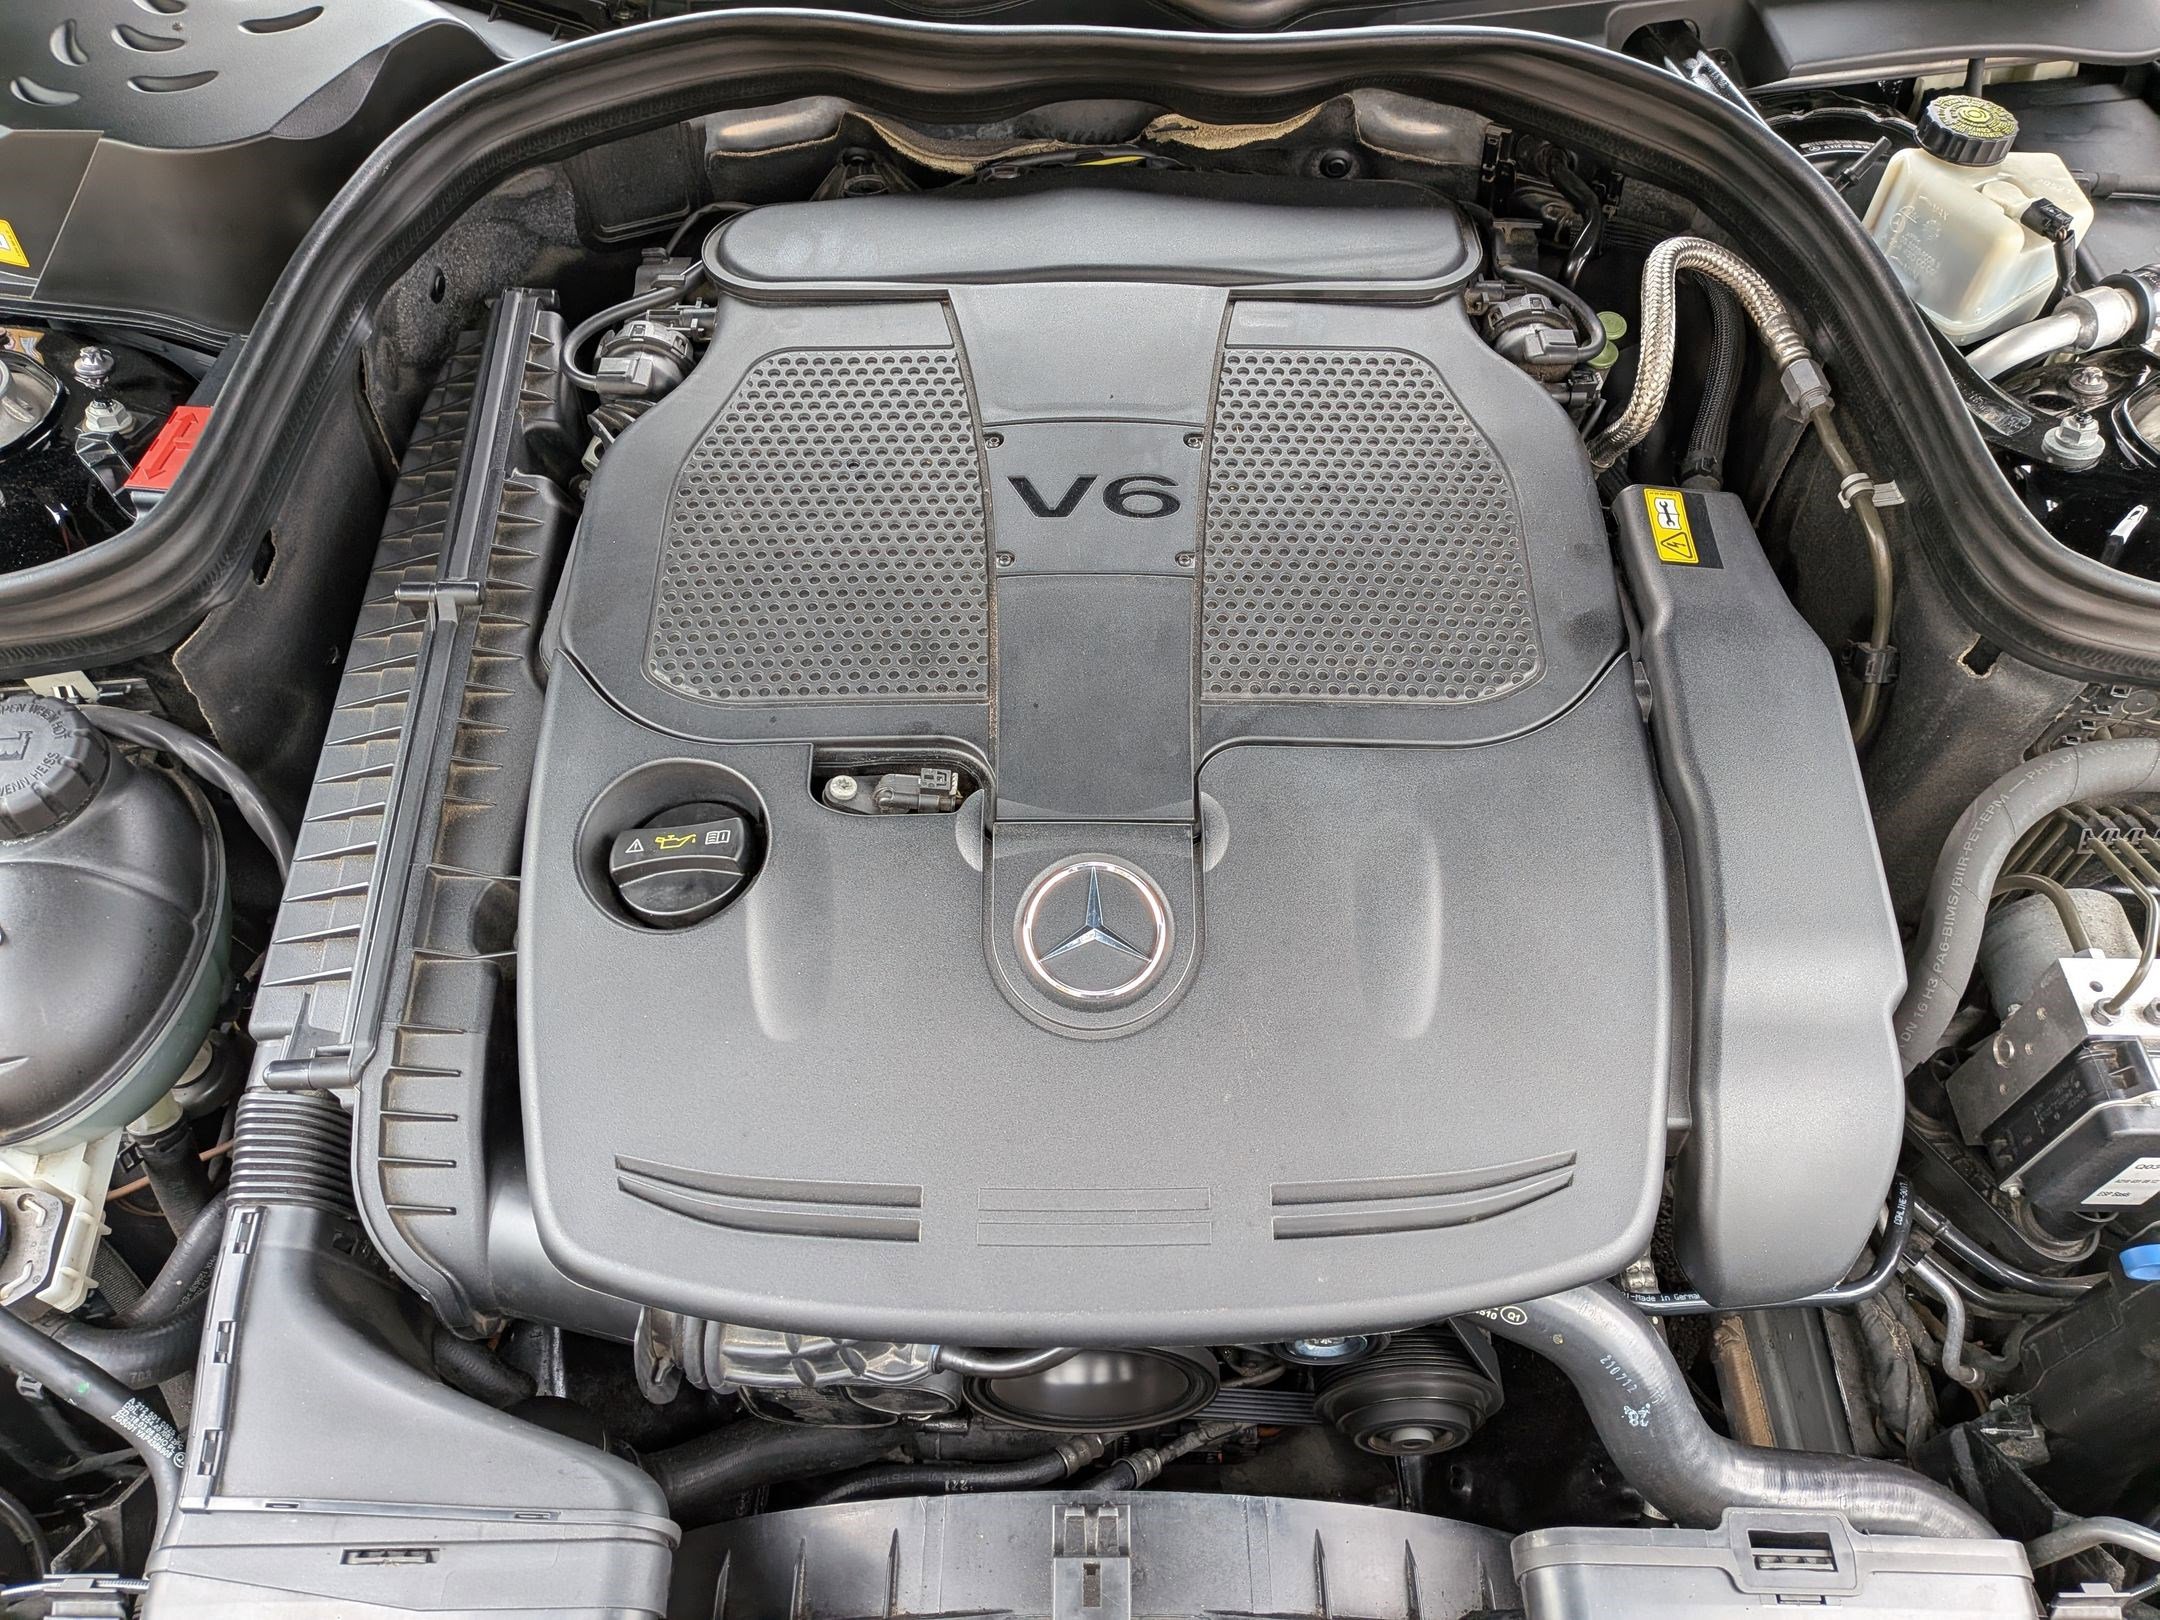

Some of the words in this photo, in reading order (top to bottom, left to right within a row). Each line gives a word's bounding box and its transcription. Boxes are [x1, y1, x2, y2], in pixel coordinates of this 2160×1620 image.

[1007, 473, 1181, 519] V6
[0, 703, 26, 714] PEN
[30, 752, 60, 780] HEISS
[1900, 1021, 1918, 1042] DN
[1913, 1003, 1928, 1018] 16
[1922, 977, 1939, 1000] H3
[1660, 1294, 1671, 1302] in
[1507, 1311, 1521, 1322] Q1
[1600, 1354, 1638, 1394] 210712
[129, 1397, 136, 1405] A
[135, 1401, 149, 1413] 212
